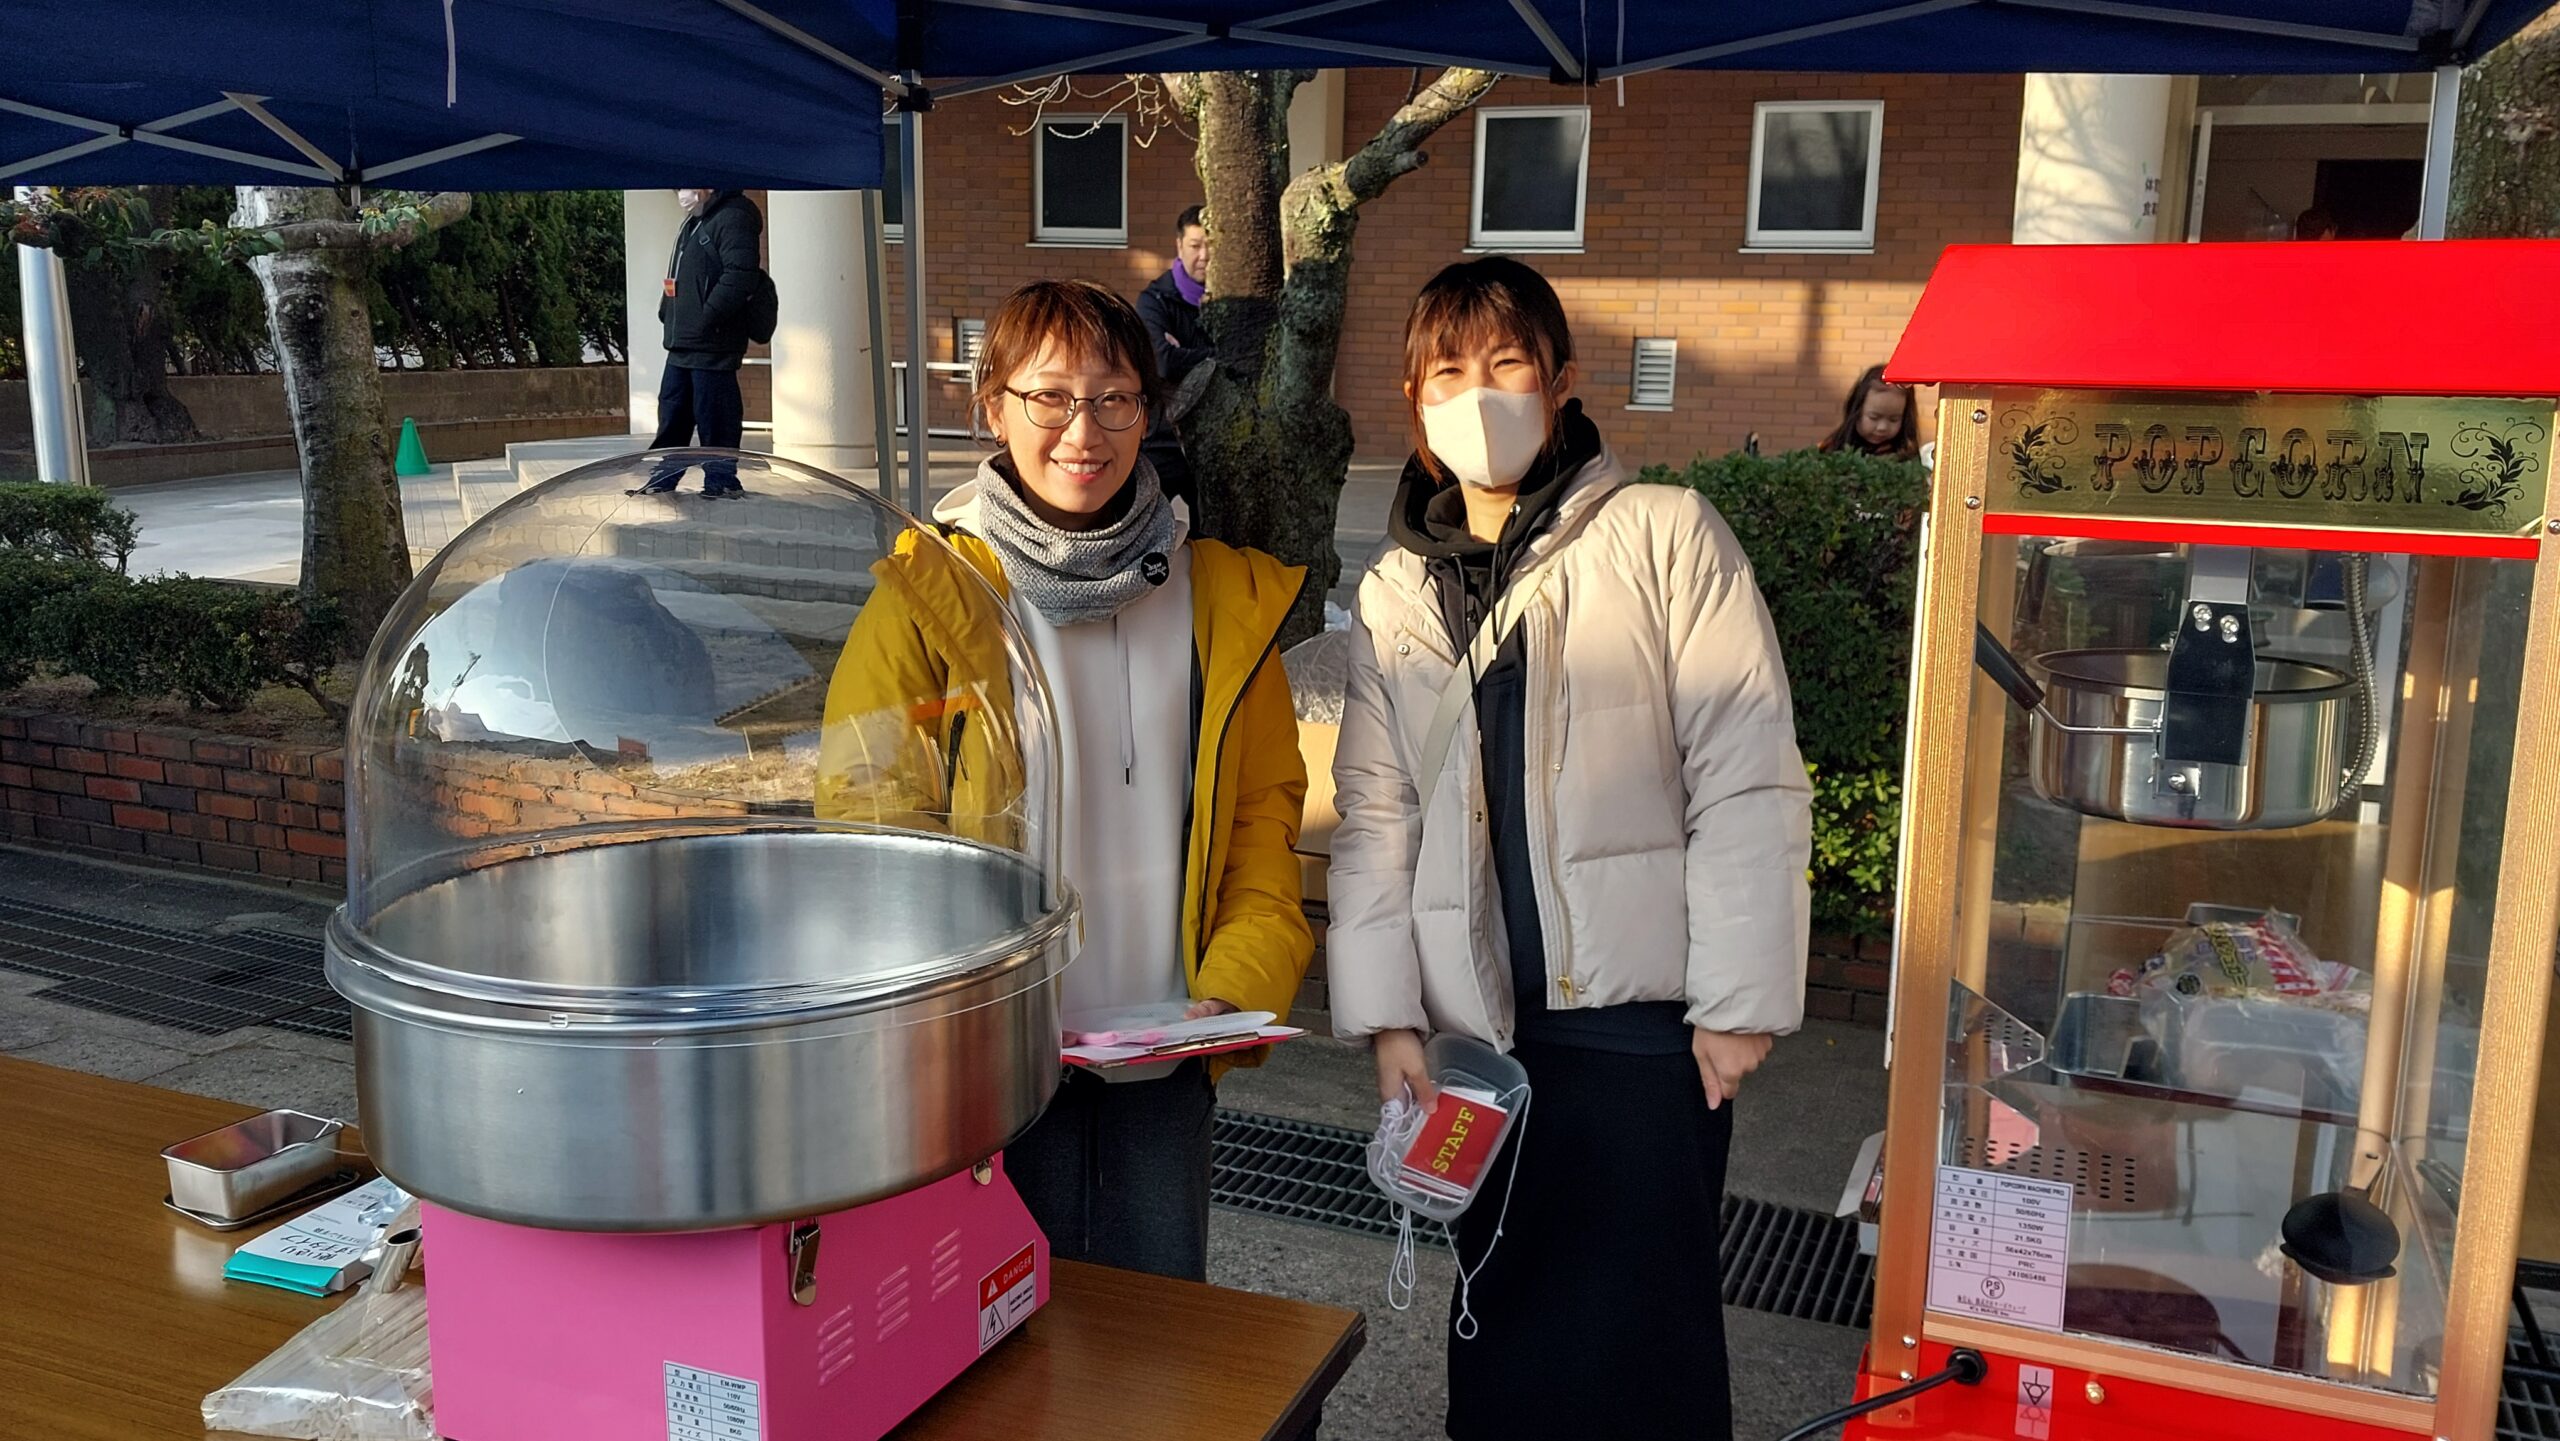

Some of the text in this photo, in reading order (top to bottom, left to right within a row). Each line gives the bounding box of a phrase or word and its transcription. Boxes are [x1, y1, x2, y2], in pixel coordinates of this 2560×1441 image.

[2092, 422, 2430, 504] POPCORN
[1432, 1106, 1475, 1173] STAFF
[2022, 1197, 2041, 1206] 100V
[2015, 1208, 2046, 1218] 50/60Hz
[1003, 1255, 1033, 1285] DANGER
[2018, 1260, 2036, 1269] PRC
